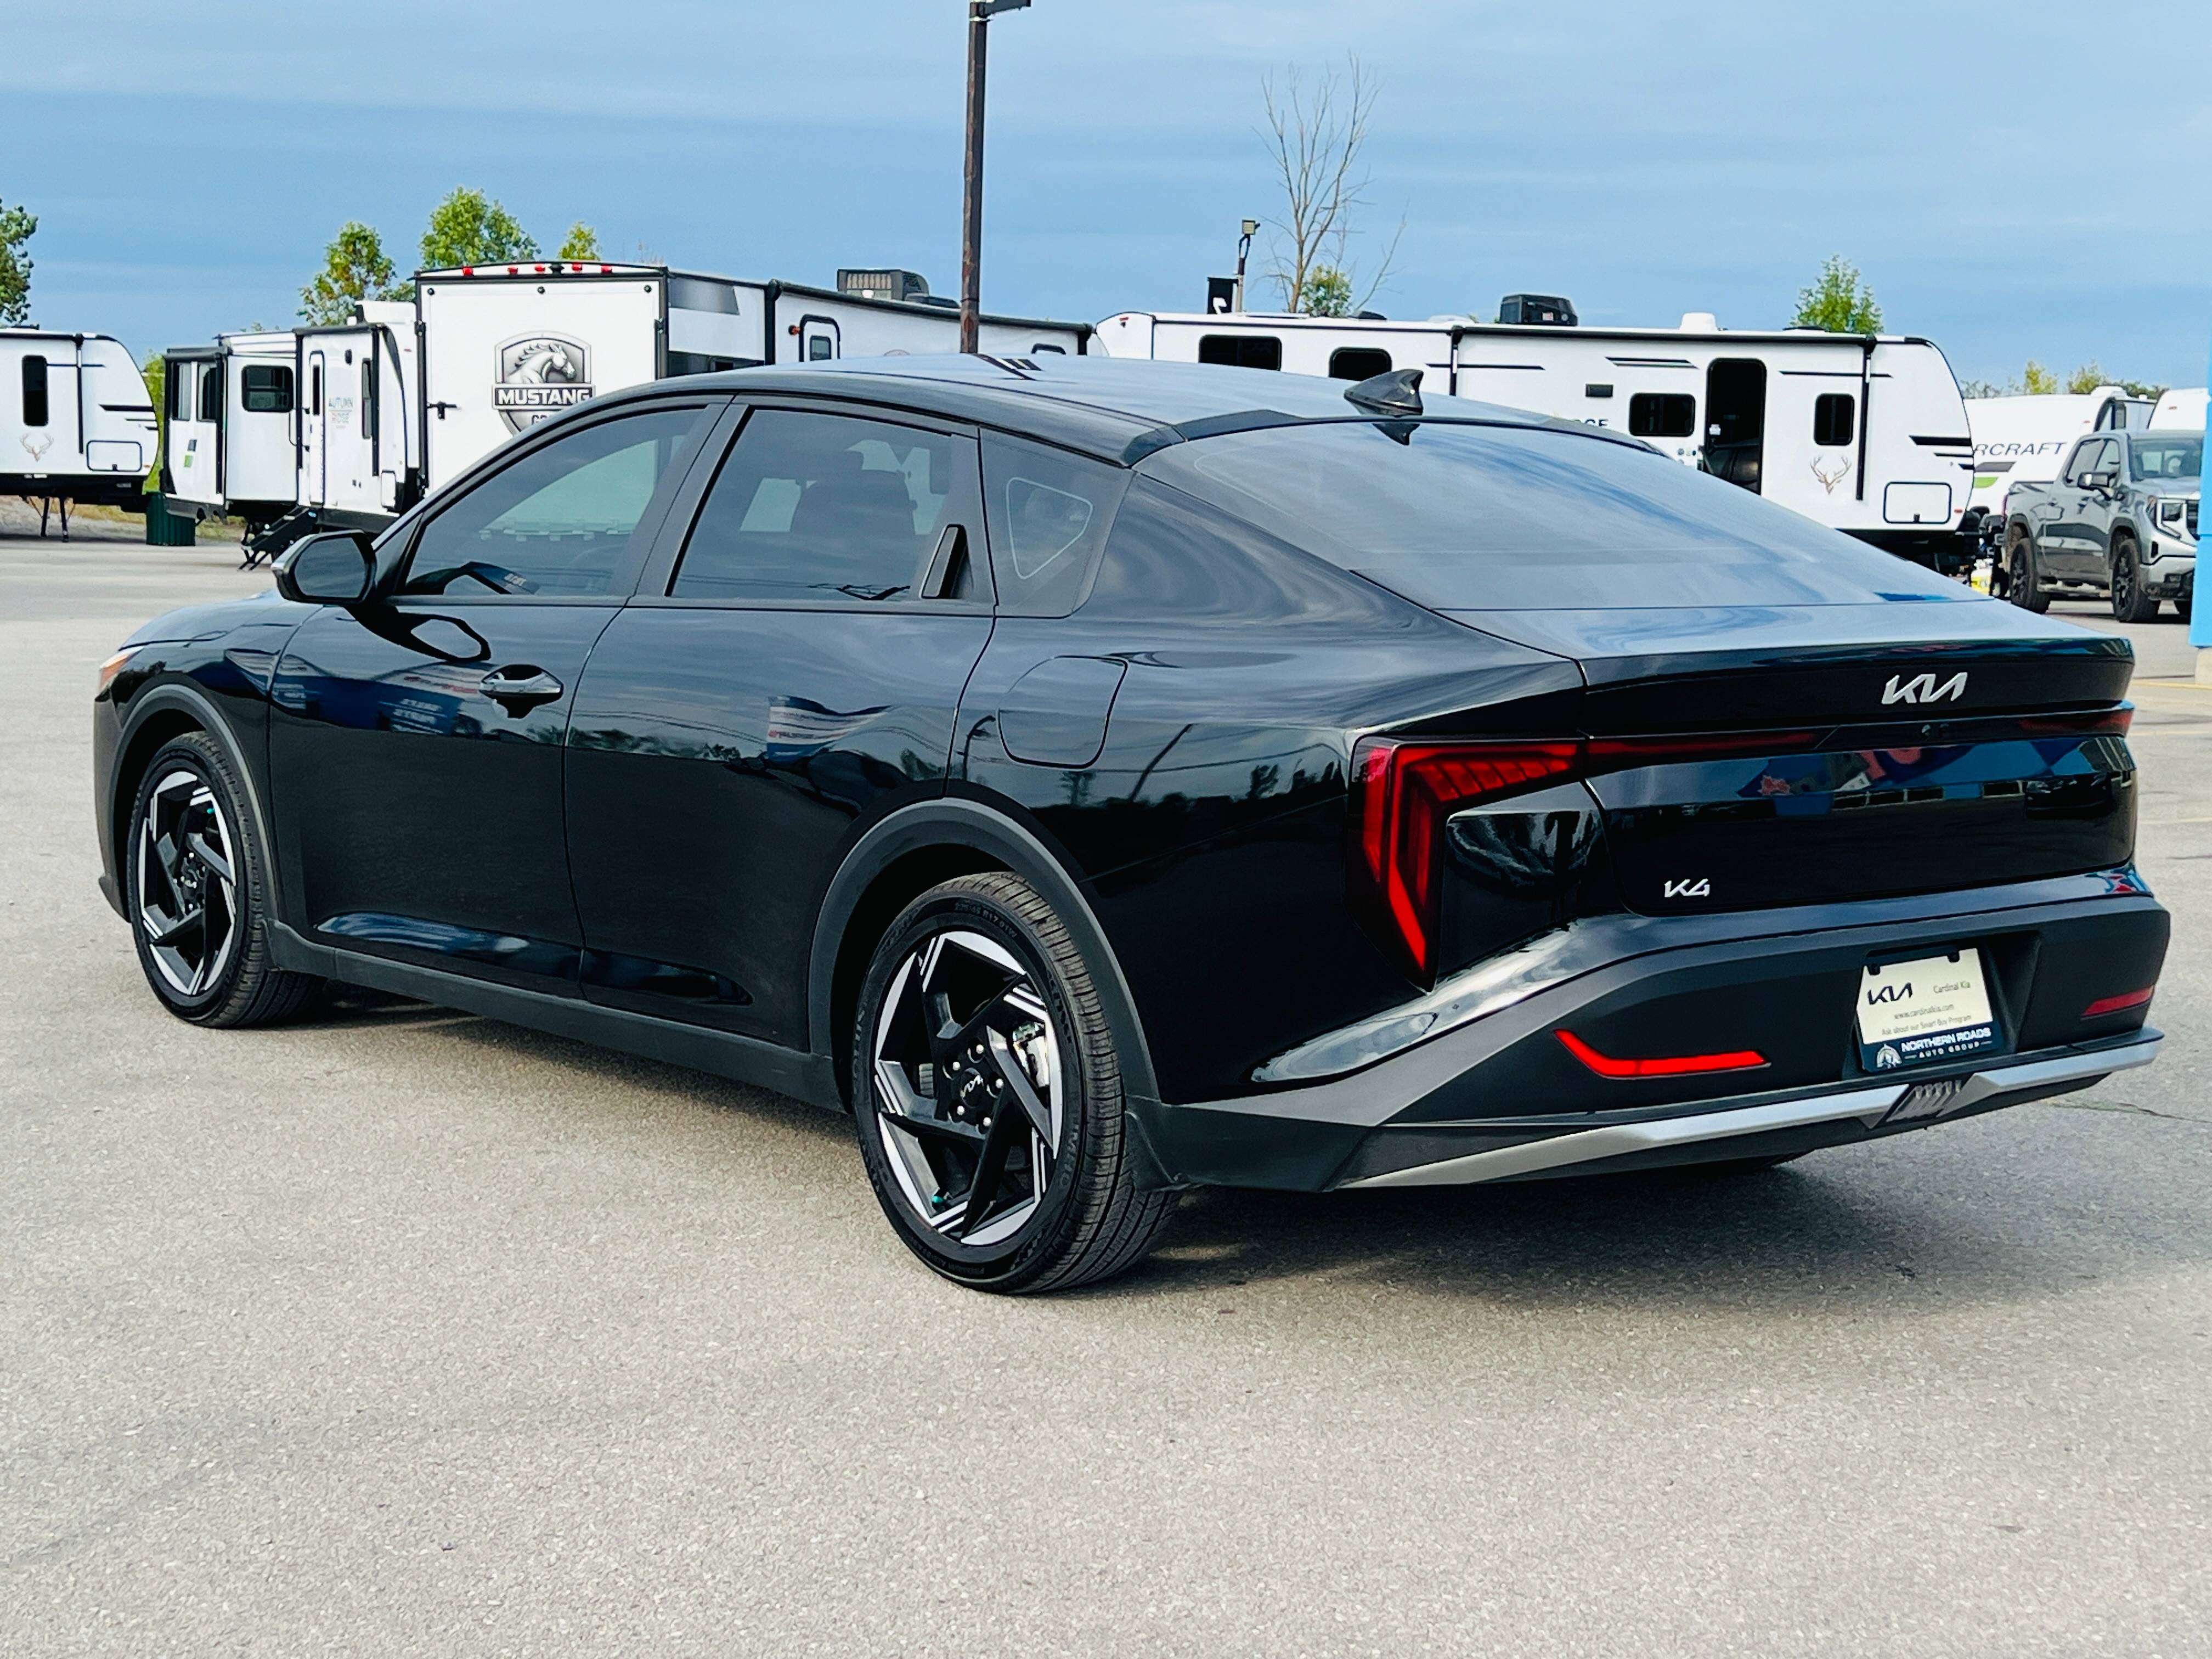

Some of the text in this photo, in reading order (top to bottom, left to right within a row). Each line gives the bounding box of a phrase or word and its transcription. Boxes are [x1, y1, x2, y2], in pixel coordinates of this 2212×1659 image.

[498, 388, 590, 405] MUSTANG
[1882, 672, 1968, 705] KIA
[1664, 878, 1711, 898] K4
[1867, 981, 1914, 1006] KIA
[1933, 980, 1971, 994] Cardinal Kia
[1893, 1025, 1909, 1034] about
[1948, 1015, 1971, 1025] Program
[1901, 1027, 1992, 1053] NORTHERN ROADS
[1919, 1041, 1980, 1058] AUTO GROUP
